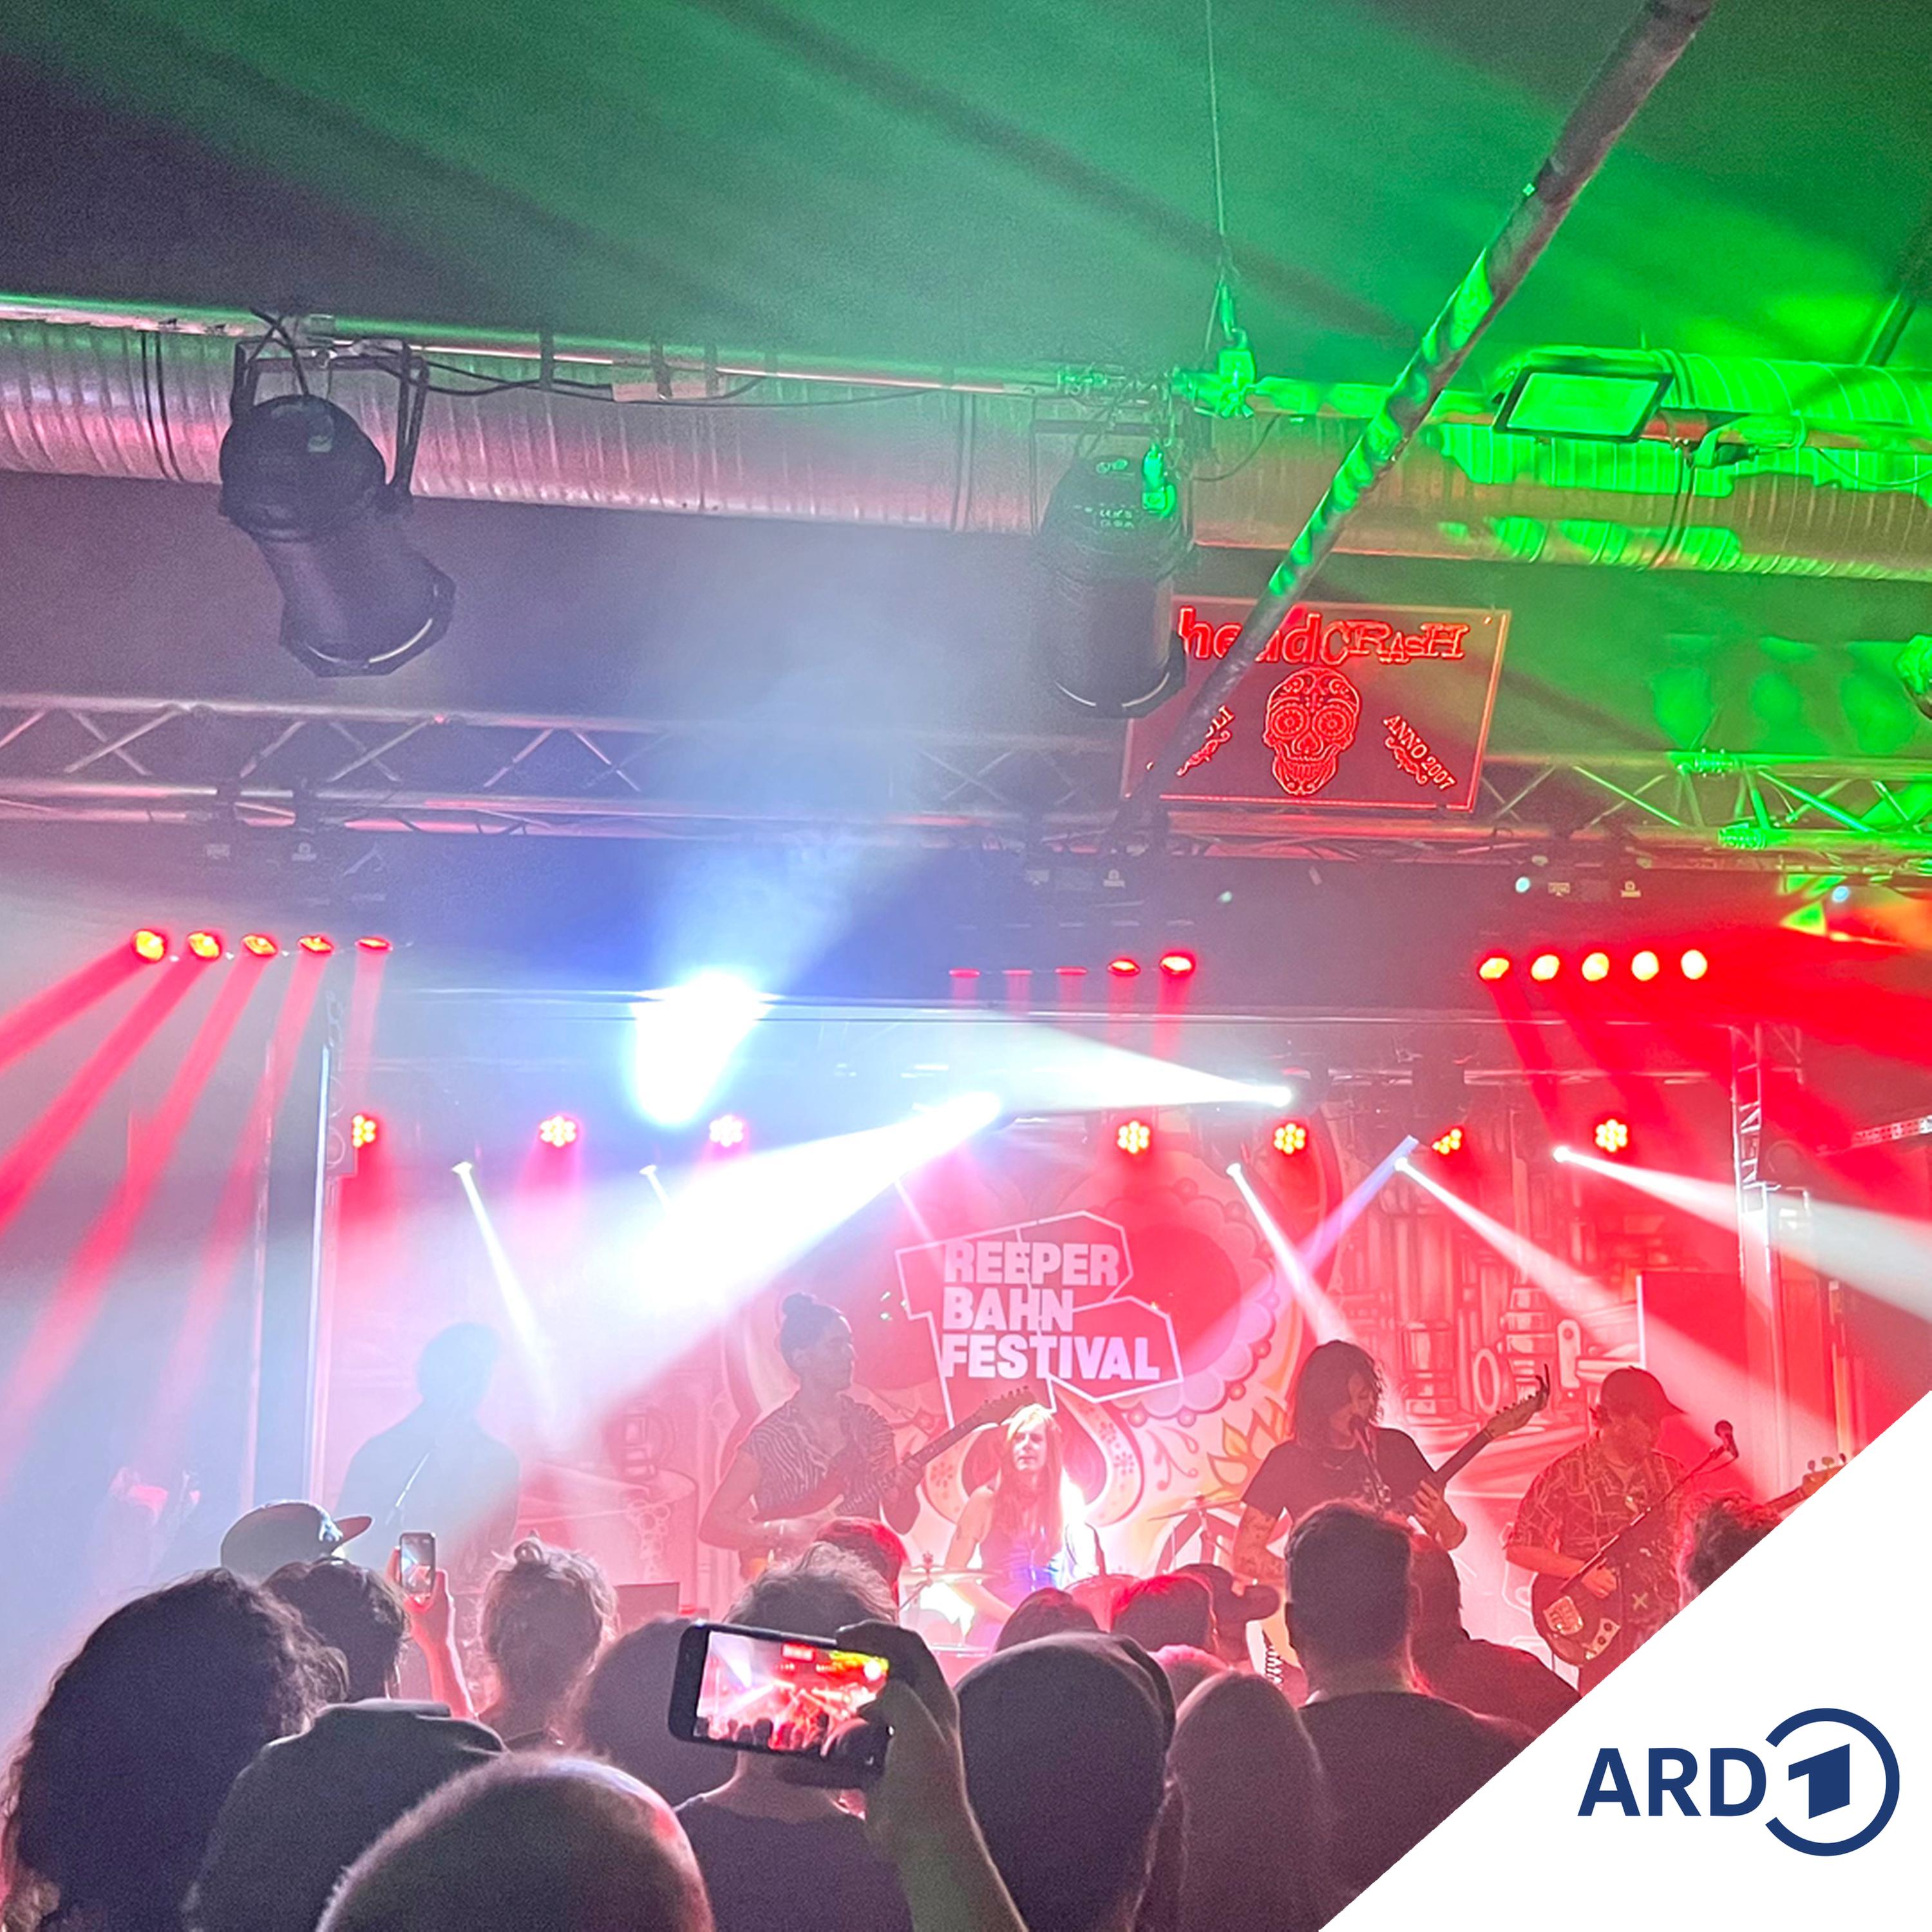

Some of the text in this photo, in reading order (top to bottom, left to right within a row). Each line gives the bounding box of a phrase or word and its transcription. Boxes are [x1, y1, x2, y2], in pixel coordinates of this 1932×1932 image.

[1383, 715, 1455, 790] ANNO 2007
[943, 1240, 1121, 1286] REEPER
[942, 1286, 1074, 1332] BAHN
[940, 1333, 1161, 1381] FESTIVAL
